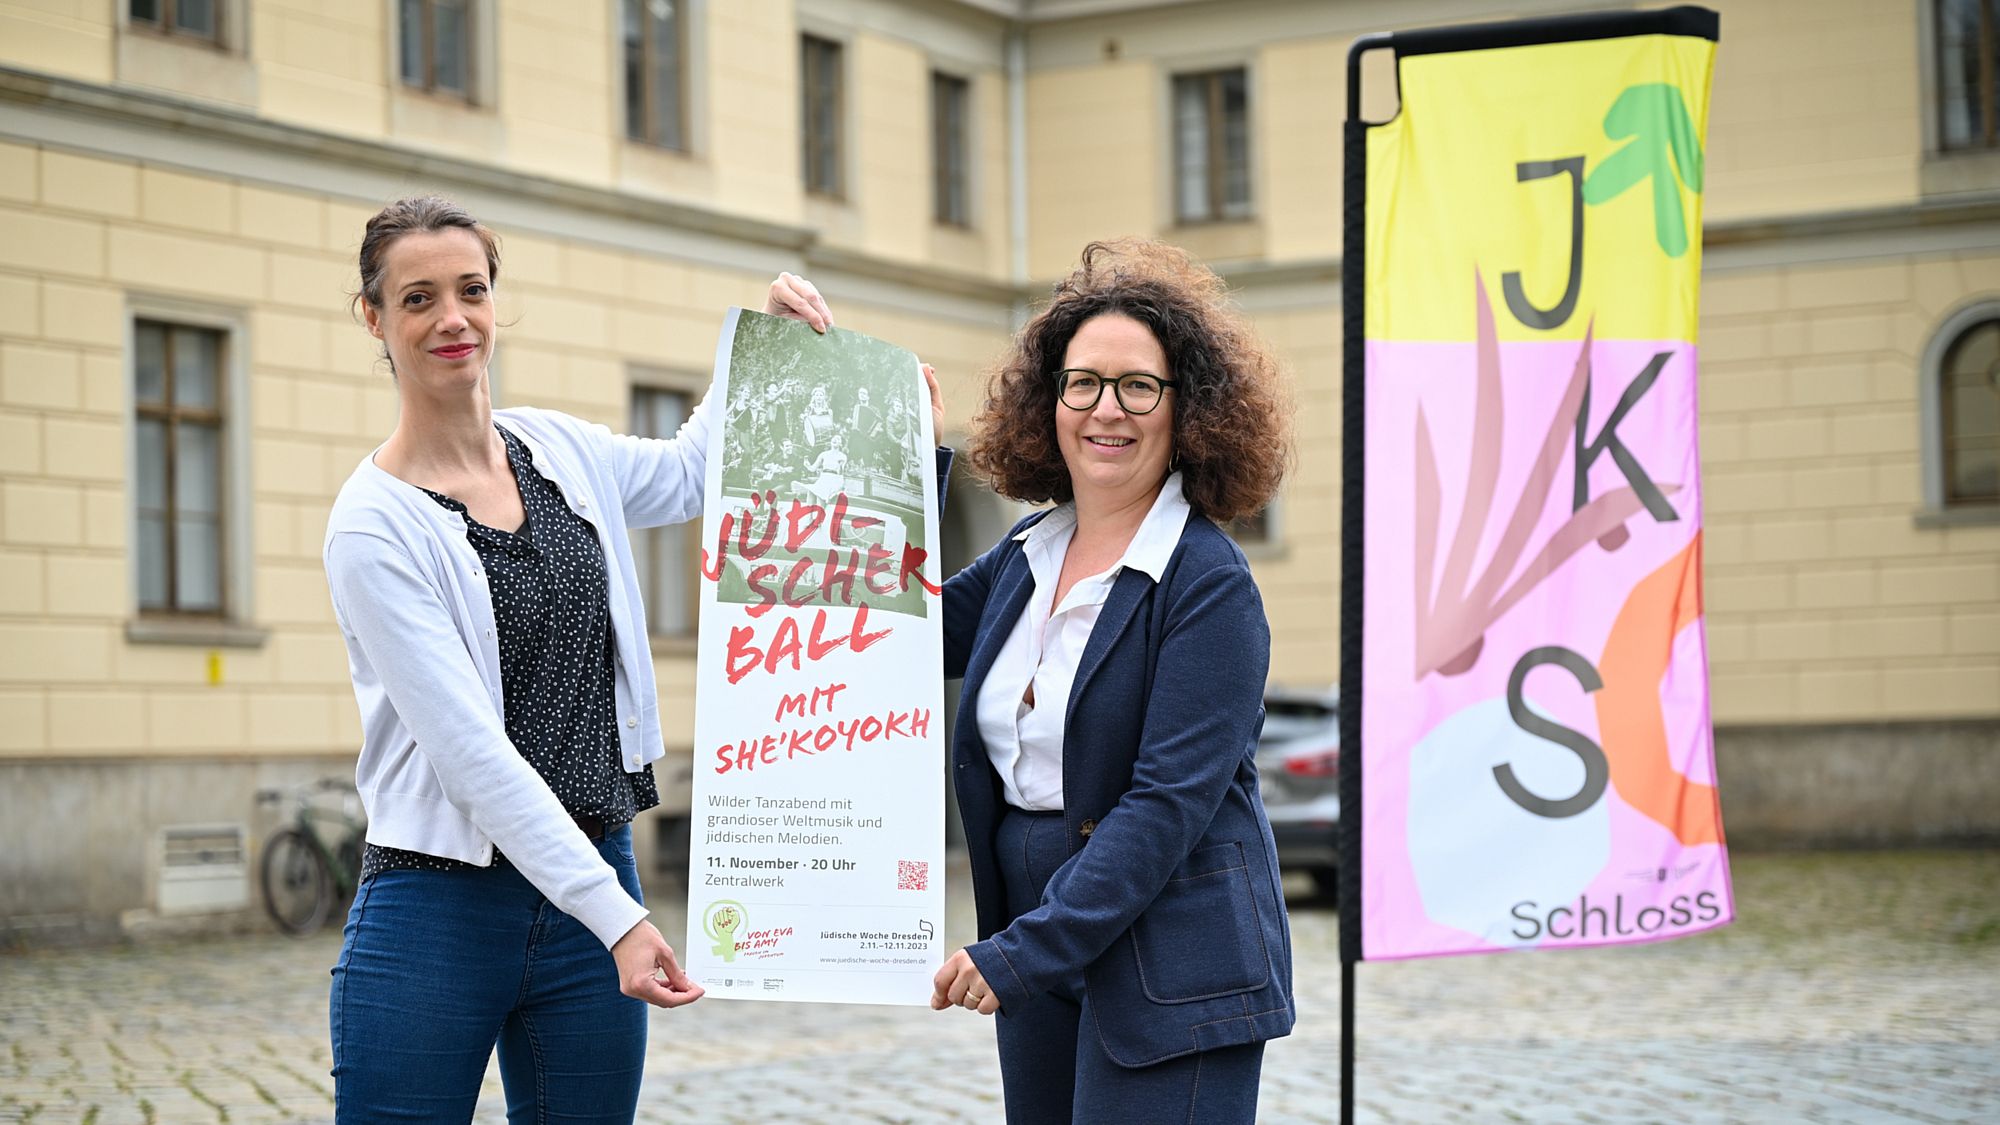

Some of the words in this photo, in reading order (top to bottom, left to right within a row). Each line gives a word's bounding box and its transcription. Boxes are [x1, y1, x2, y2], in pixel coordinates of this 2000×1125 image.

[701, 490, 885, 582] JÜDI-
[745, 542, 942, 618] SCHER
[726, 601, 894, 685] BALL
[775, 683, 847, 723] MIT
[715, 708, 930, 774] SHE'KOYOKH
[708, 795, 751, 808] Wilder
[755, 796, 826, 809] Tanzabend
[830, 798, 852, 810] mit
[707, 814, 779, 828] grandioser
[783, 815, 854, 828] Weltmusik
[857, 817, 883, 829] und
[705, 830, 774, 845] jiddischen
[777, 832, 843, 845] Melodien.
[706, 856, 725, 868] 11.
[730, 857, 799, 869] November
[811, 859, 828, 870] 20
[832, 859, 856, 871] Uhr
[705, 873, 785, 888] Zentralwerk
[1510, 890, 1721, 941] Schloss
[747, 930, 771, 940] VON
[774, 927, 793, 936] EVA
[820, 931, 857, 940] Jüdische
[860, 932, 889, 940] Woche
[892, 932, 928, 940] Dresden
[734, 941, 752, 952] BIS
[754, 938, 778, 949] AMY
